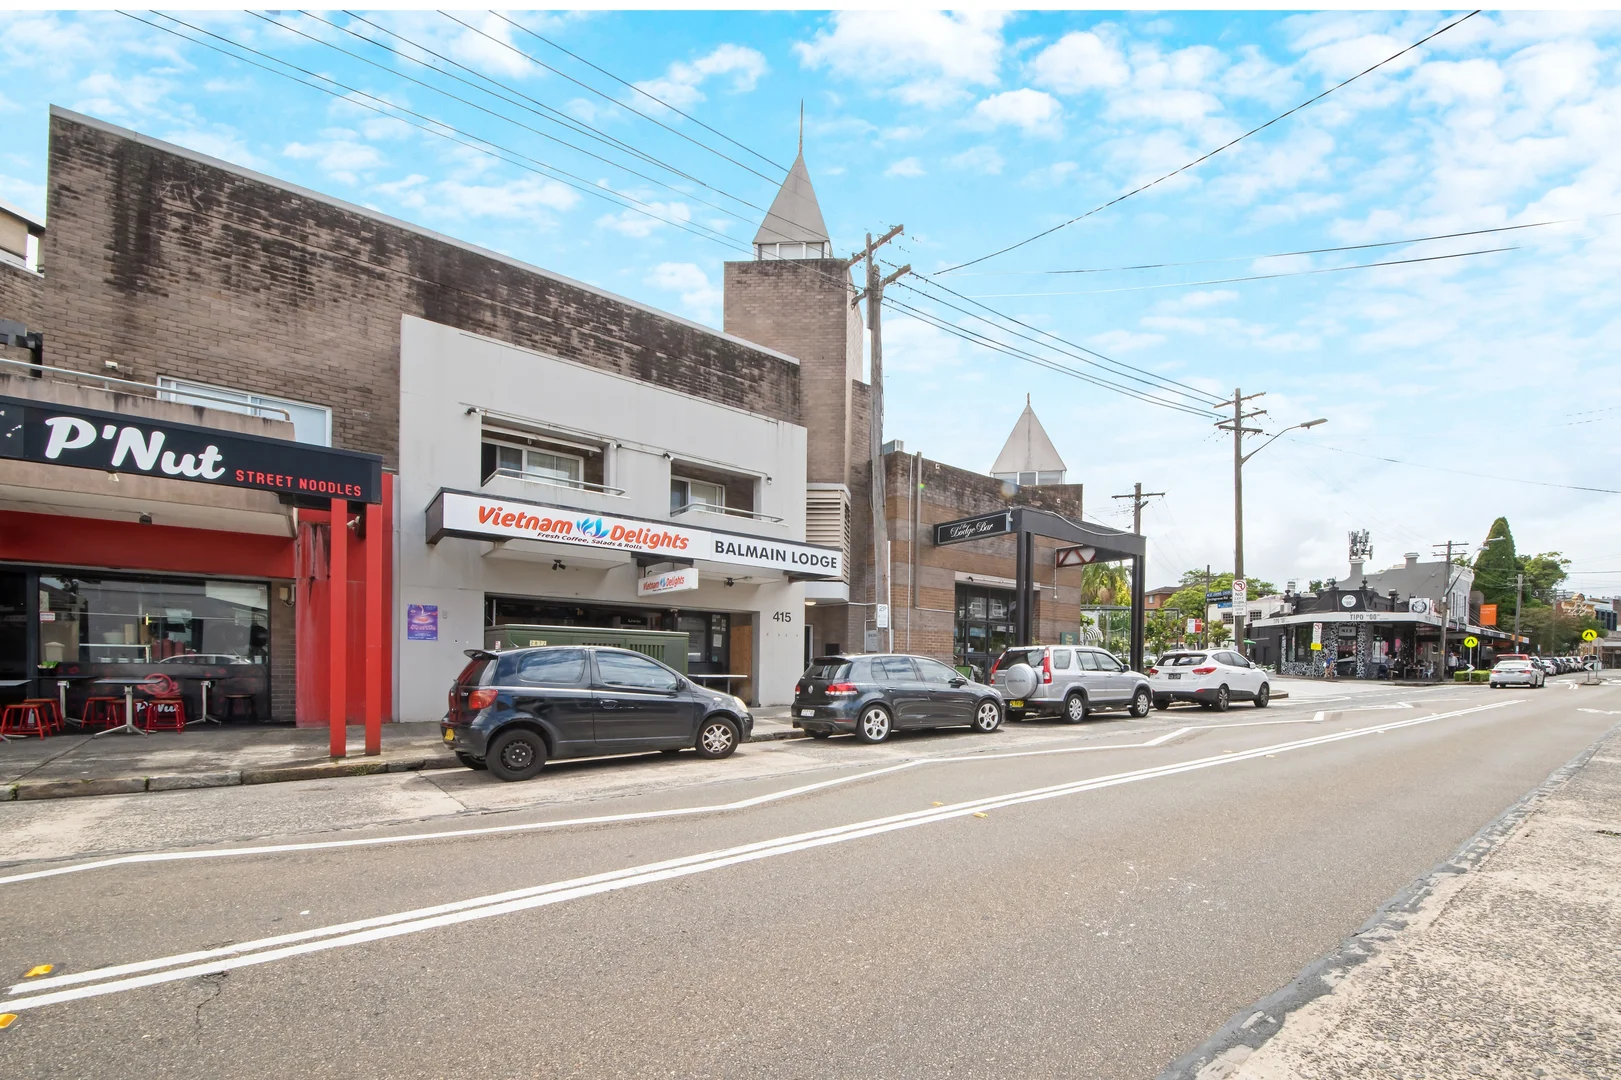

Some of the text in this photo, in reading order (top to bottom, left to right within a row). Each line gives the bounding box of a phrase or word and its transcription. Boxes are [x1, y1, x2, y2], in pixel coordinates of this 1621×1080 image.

[45, 416, 226, 480] P'Nut
[235, 469, 362, 497] STREET NOODLES
[478, 505, 689, 550] Vietnam Delights
[950, 520, 994, 538] Lodge Bar
[536, 532, 560, 540] Fresh
[561, 535, 589, 544] Coffee,
[591, 539, 616, 547] Salads
[715, 540, 837, 569] BALMAIN LODGE
[643, 581, 660, 590] Vietnam
[666, 576, 685, 588] Delights
[772, 611, 792, 623] 415
